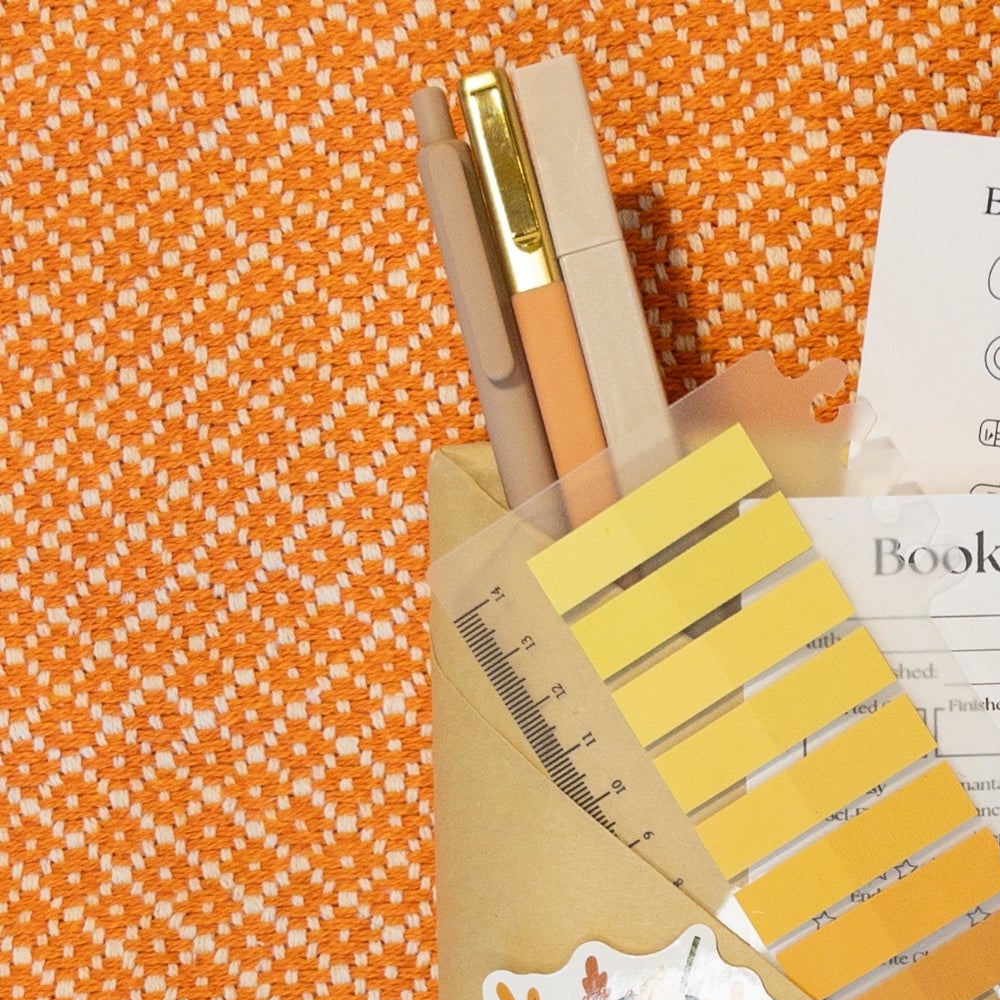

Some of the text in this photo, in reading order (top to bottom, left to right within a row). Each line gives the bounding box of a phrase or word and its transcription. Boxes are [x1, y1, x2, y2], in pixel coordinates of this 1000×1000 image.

[490, 586, 506, 602] 14
[520, 635, 537, 651] 13
[550, 683, 567, 699] 12
[581, 731, 597, 747] 11
[611, 779, 627, 795] 10
